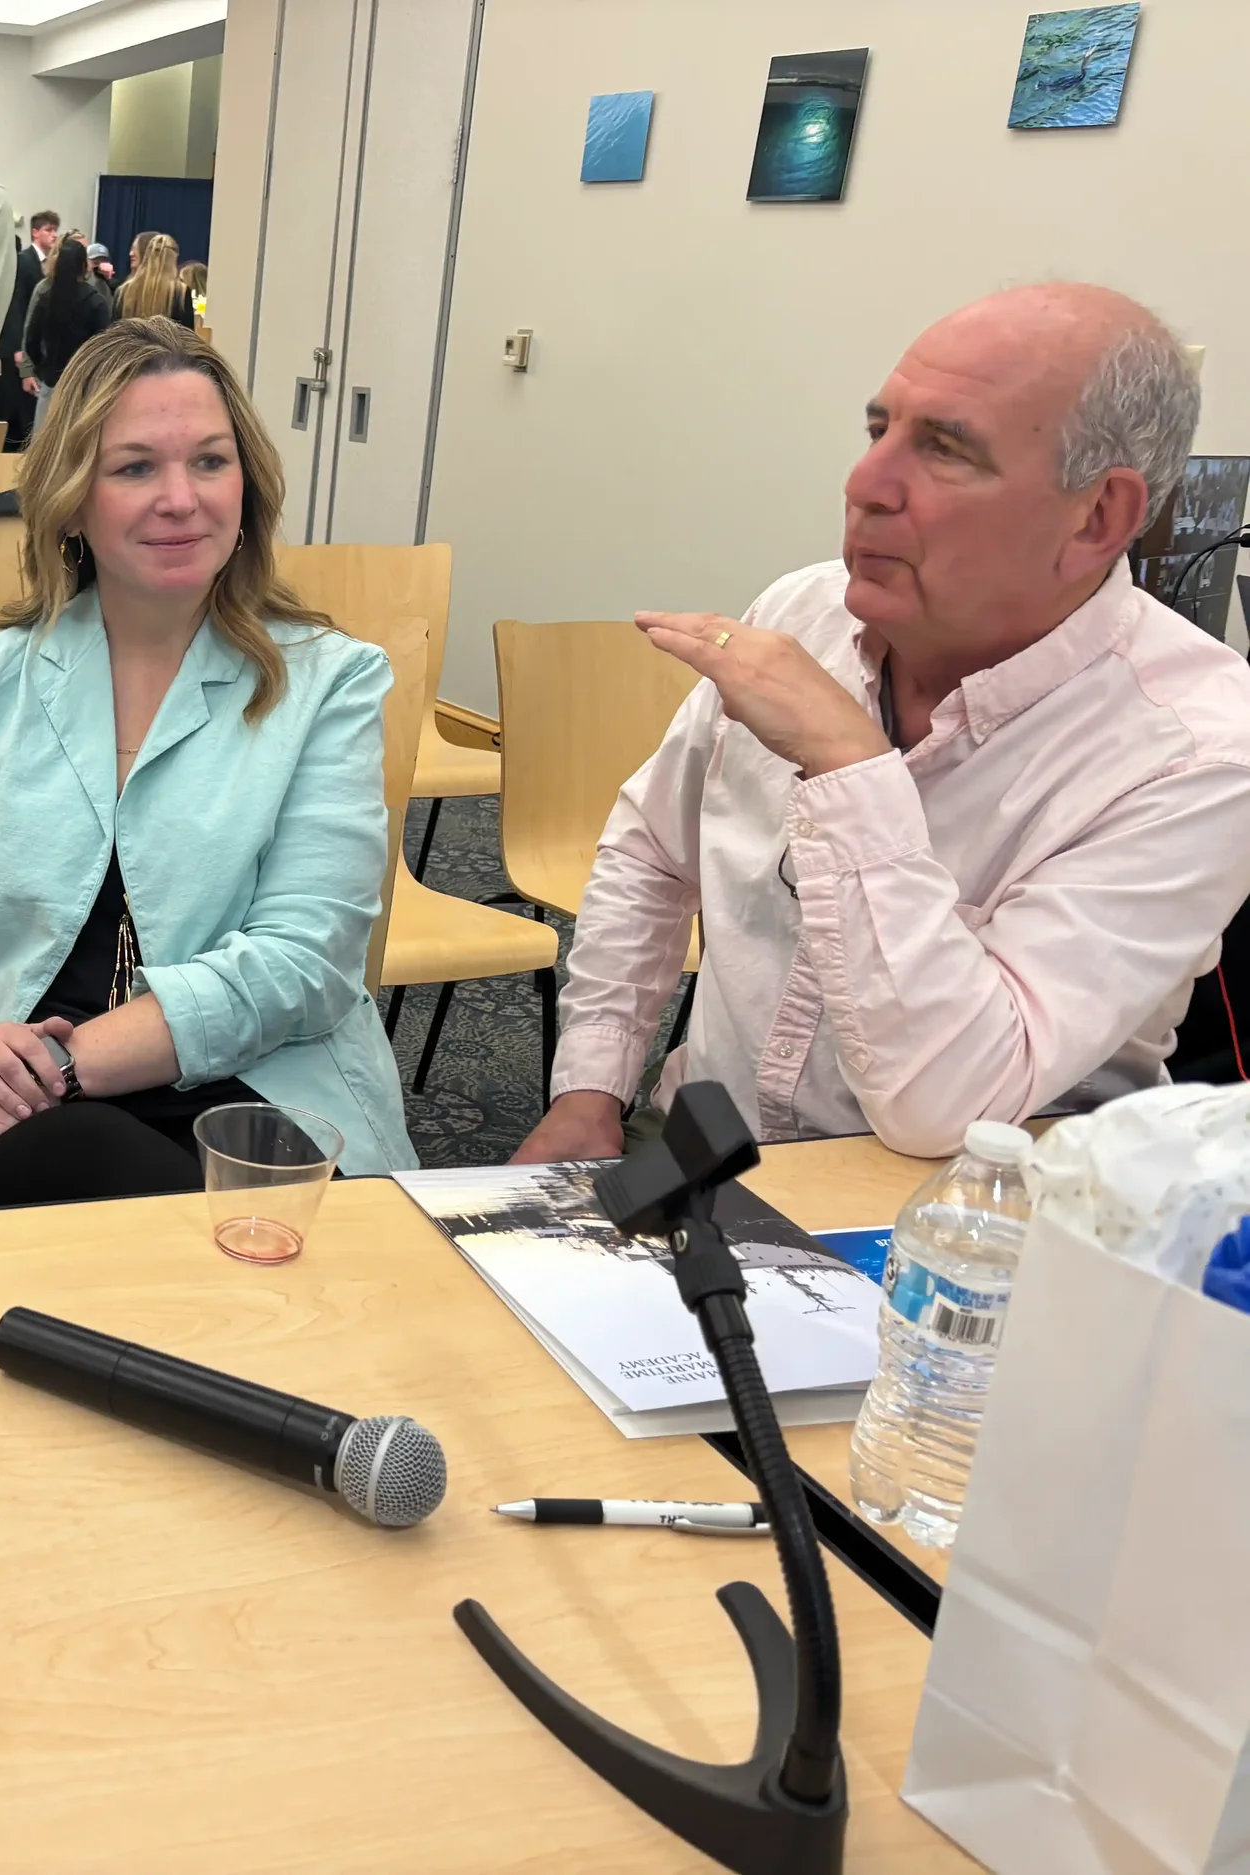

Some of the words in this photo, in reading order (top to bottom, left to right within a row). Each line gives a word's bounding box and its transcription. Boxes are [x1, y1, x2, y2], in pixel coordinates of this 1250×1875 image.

[618, 1351, 701, 1371] ACADEMY
[620, 1360, 715, 1380] MARITIME
[662, 1369, 720, 1385] MAINE
